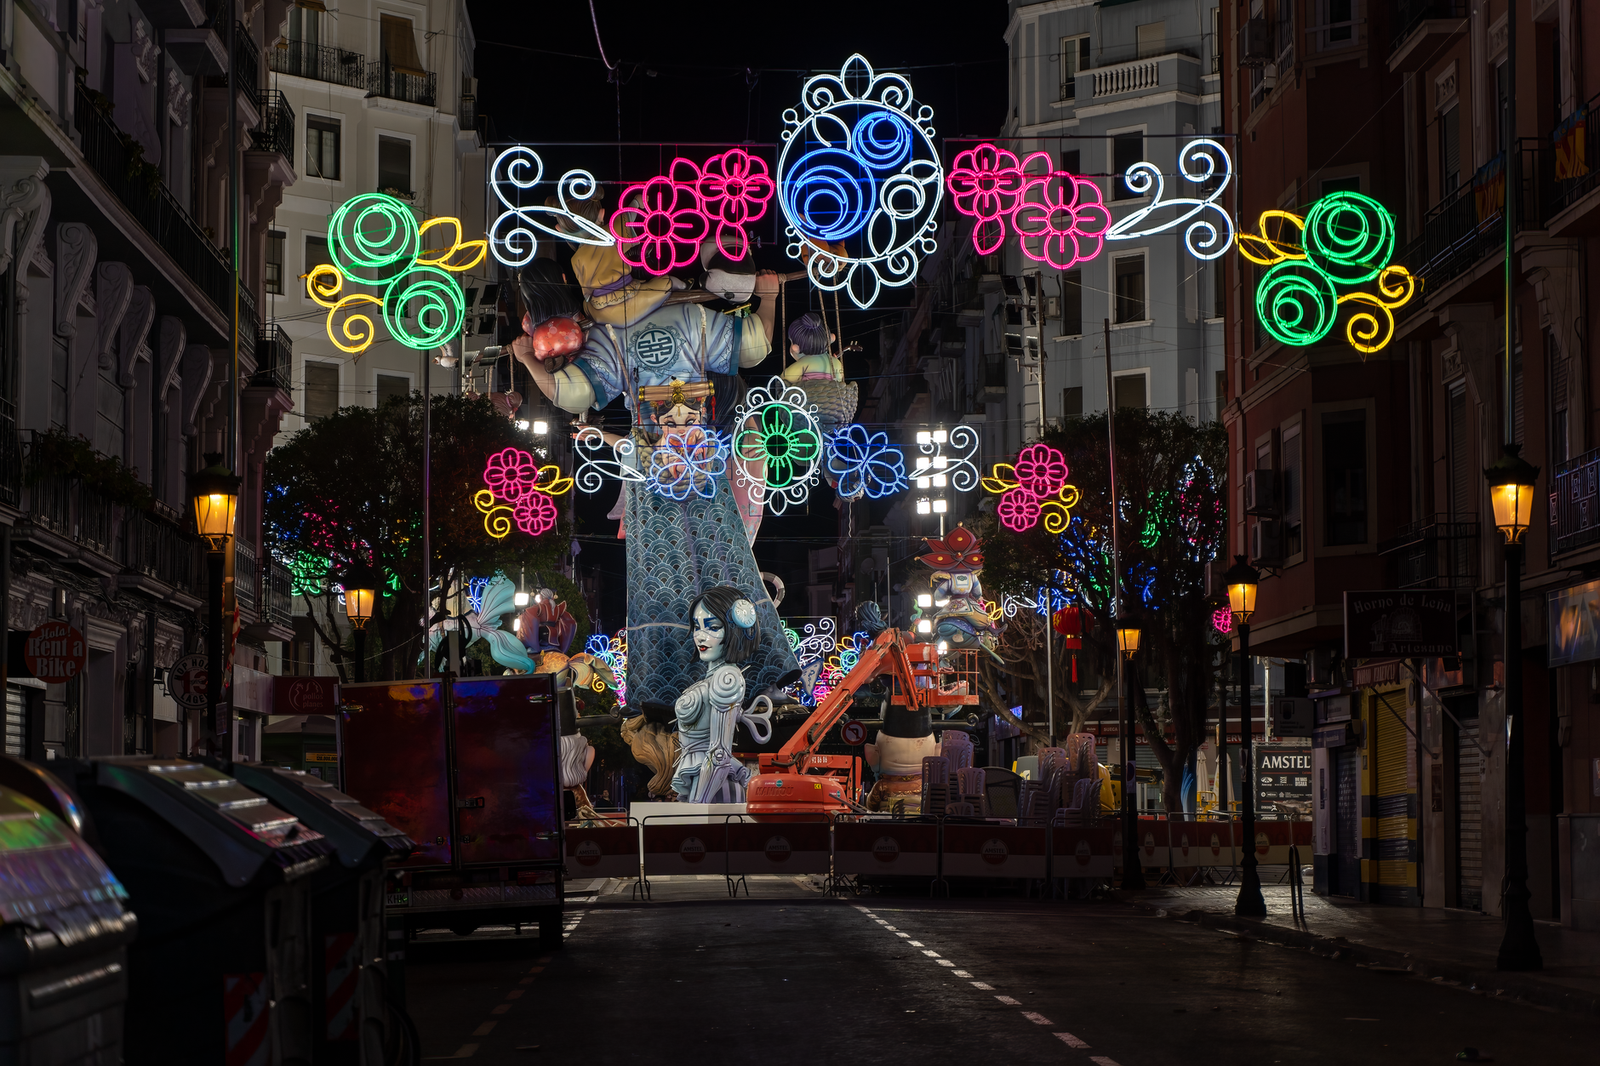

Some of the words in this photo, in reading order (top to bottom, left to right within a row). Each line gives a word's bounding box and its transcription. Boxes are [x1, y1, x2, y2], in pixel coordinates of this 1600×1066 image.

[1353, 598, 1394, 614] Horno
[1399, 593, 1414, 606] de
[1421, 594, 1451, 613] Leña
[37, 626, 71, 641] Hola!
[28, 638, 67, 657] Rent
[72, 640, 83, 657] a
[1388, 642, 1453, 653] Artesano
[35, 657, 76, 677] Bike
[174, 662, 188, 681] HOP
[180, 671, 208, 694] 13
[302, 700, 324, 709] planes
[303, 692, 324, 701] pollos
[1261, 755, 1311, 769] AMSTEL
